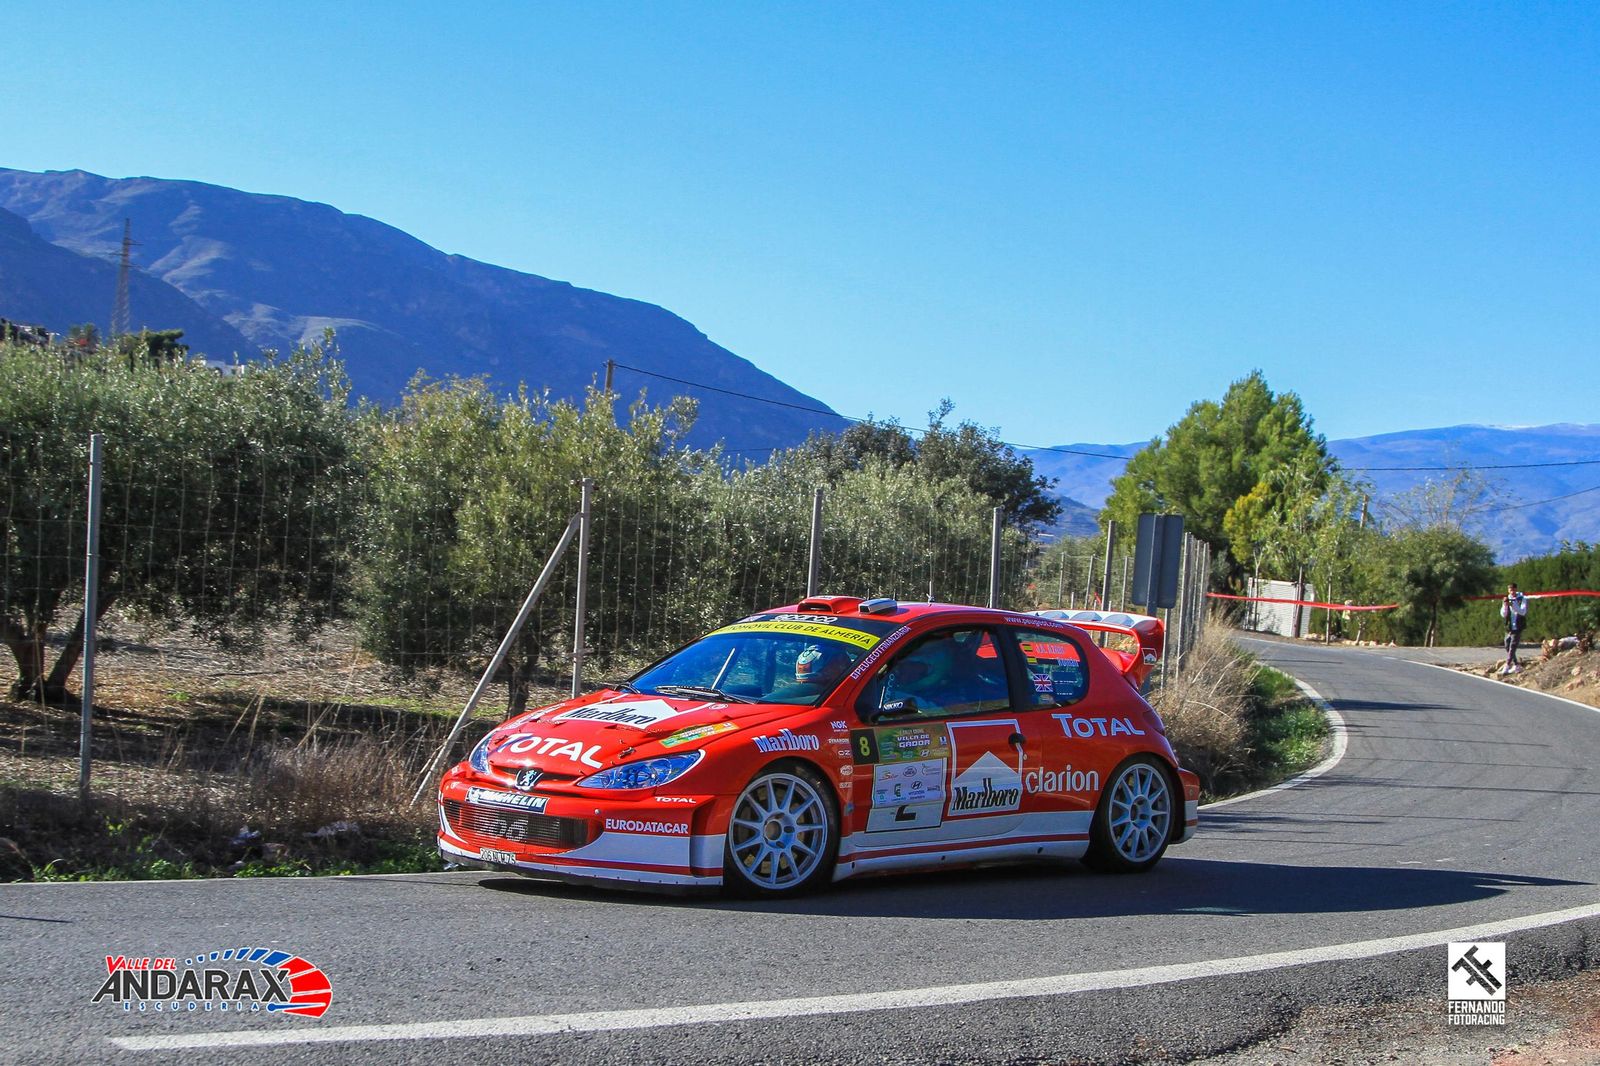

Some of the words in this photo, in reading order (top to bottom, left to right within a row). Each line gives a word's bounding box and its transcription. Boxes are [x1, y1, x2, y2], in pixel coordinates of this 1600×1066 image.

[774, 623, 802, 631] CLUB
[804, 625, 820, 633] DE
[822, 629, 872, 645] ALMERÍA
[562, 707, 658, 725] Marlboro
[830, 720, 848, 729] NGK
[1051, 713, 1146, 738] TOTAL
[497, 733, 604, 769] TOTAL
[751, 728, 820, 753] Marlboro
[859, 736, 871, 757] 8
[1025, 764, 1099, 793] clarion
[482, 790, 548, 808] MICHELIN
[655, 796, 697, 804] TOTAL
[952, 778, 1019, 811] Marlboro
[605, 818, 689, 834] EURODATACAR
